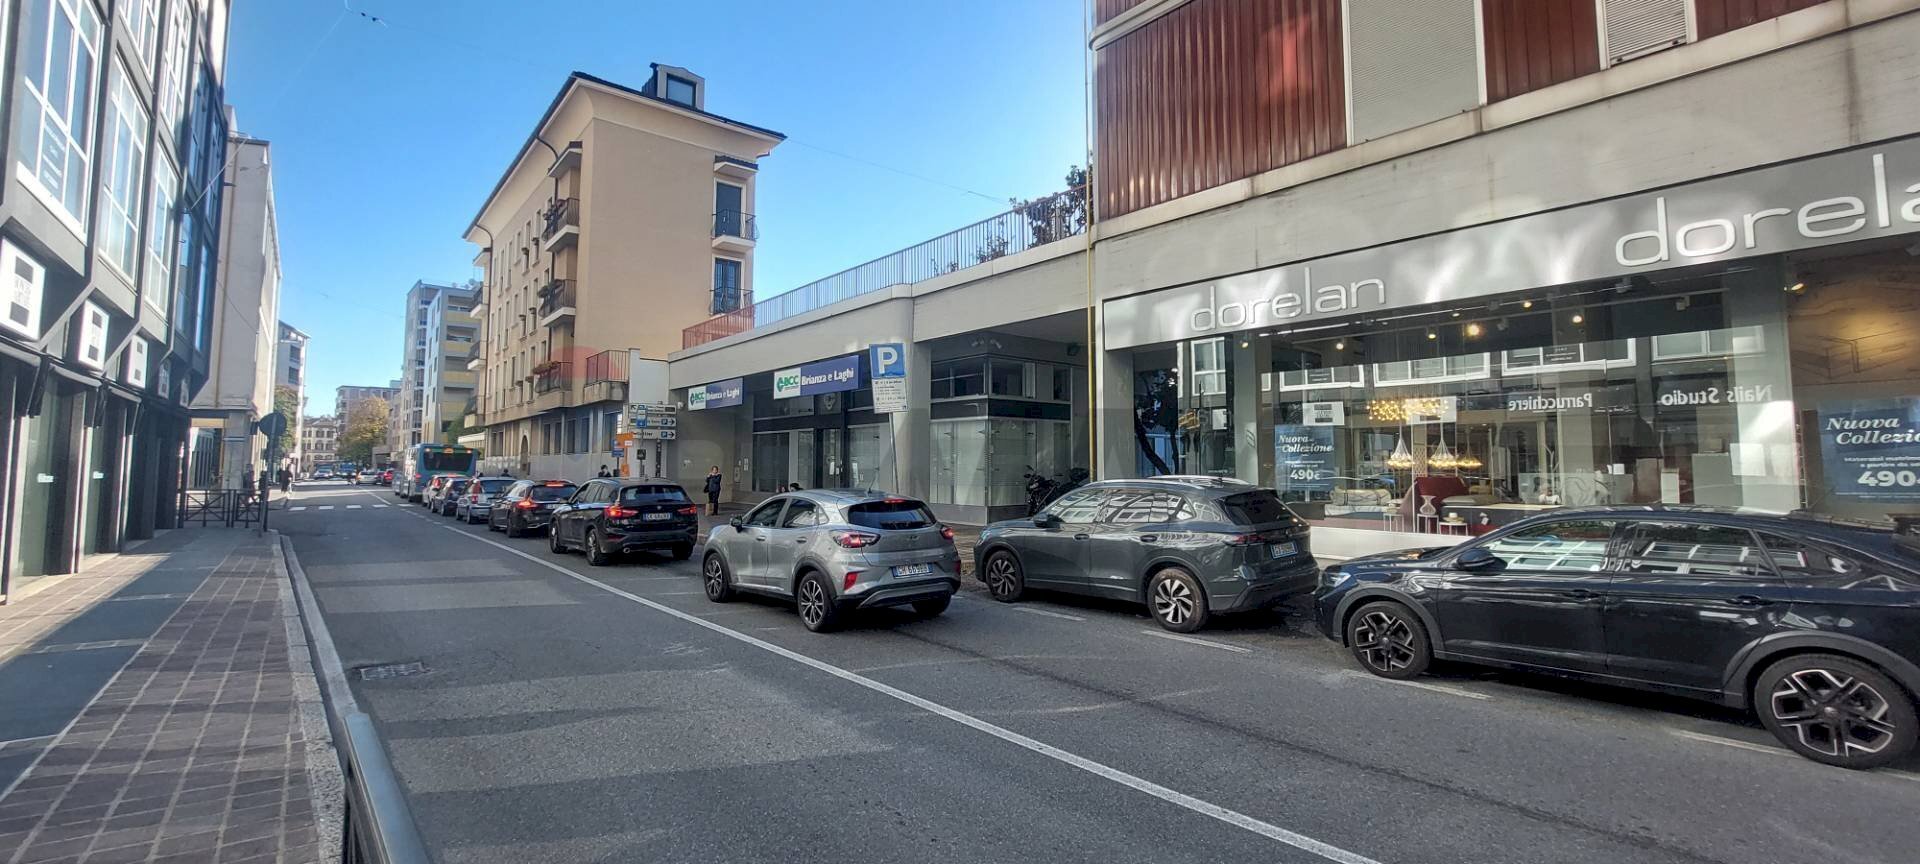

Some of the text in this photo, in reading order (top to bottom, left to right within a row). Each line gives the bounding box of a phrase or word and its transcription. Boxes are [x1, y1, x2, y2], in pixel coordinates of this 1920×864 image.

[1192, 267, 1385, 331] dorelan
[877, 347, 898, 374] P
[783, 375, 799, 386] BCC
[801, 374, 826, 386] Brianza
[834, 367, 854, 382] Laghi
[694, 391, 705, 401] BCC
[706, 390, 722, 401] Brianza
[727, 387, 740, 399] Laghi
[1826, 417, 1901, 431] Nuova
[1278, 435, 1309, 443] Nuova
[1282, 443, 1333, 453] Collezione
[1857, 470, 1920, 487] 490
